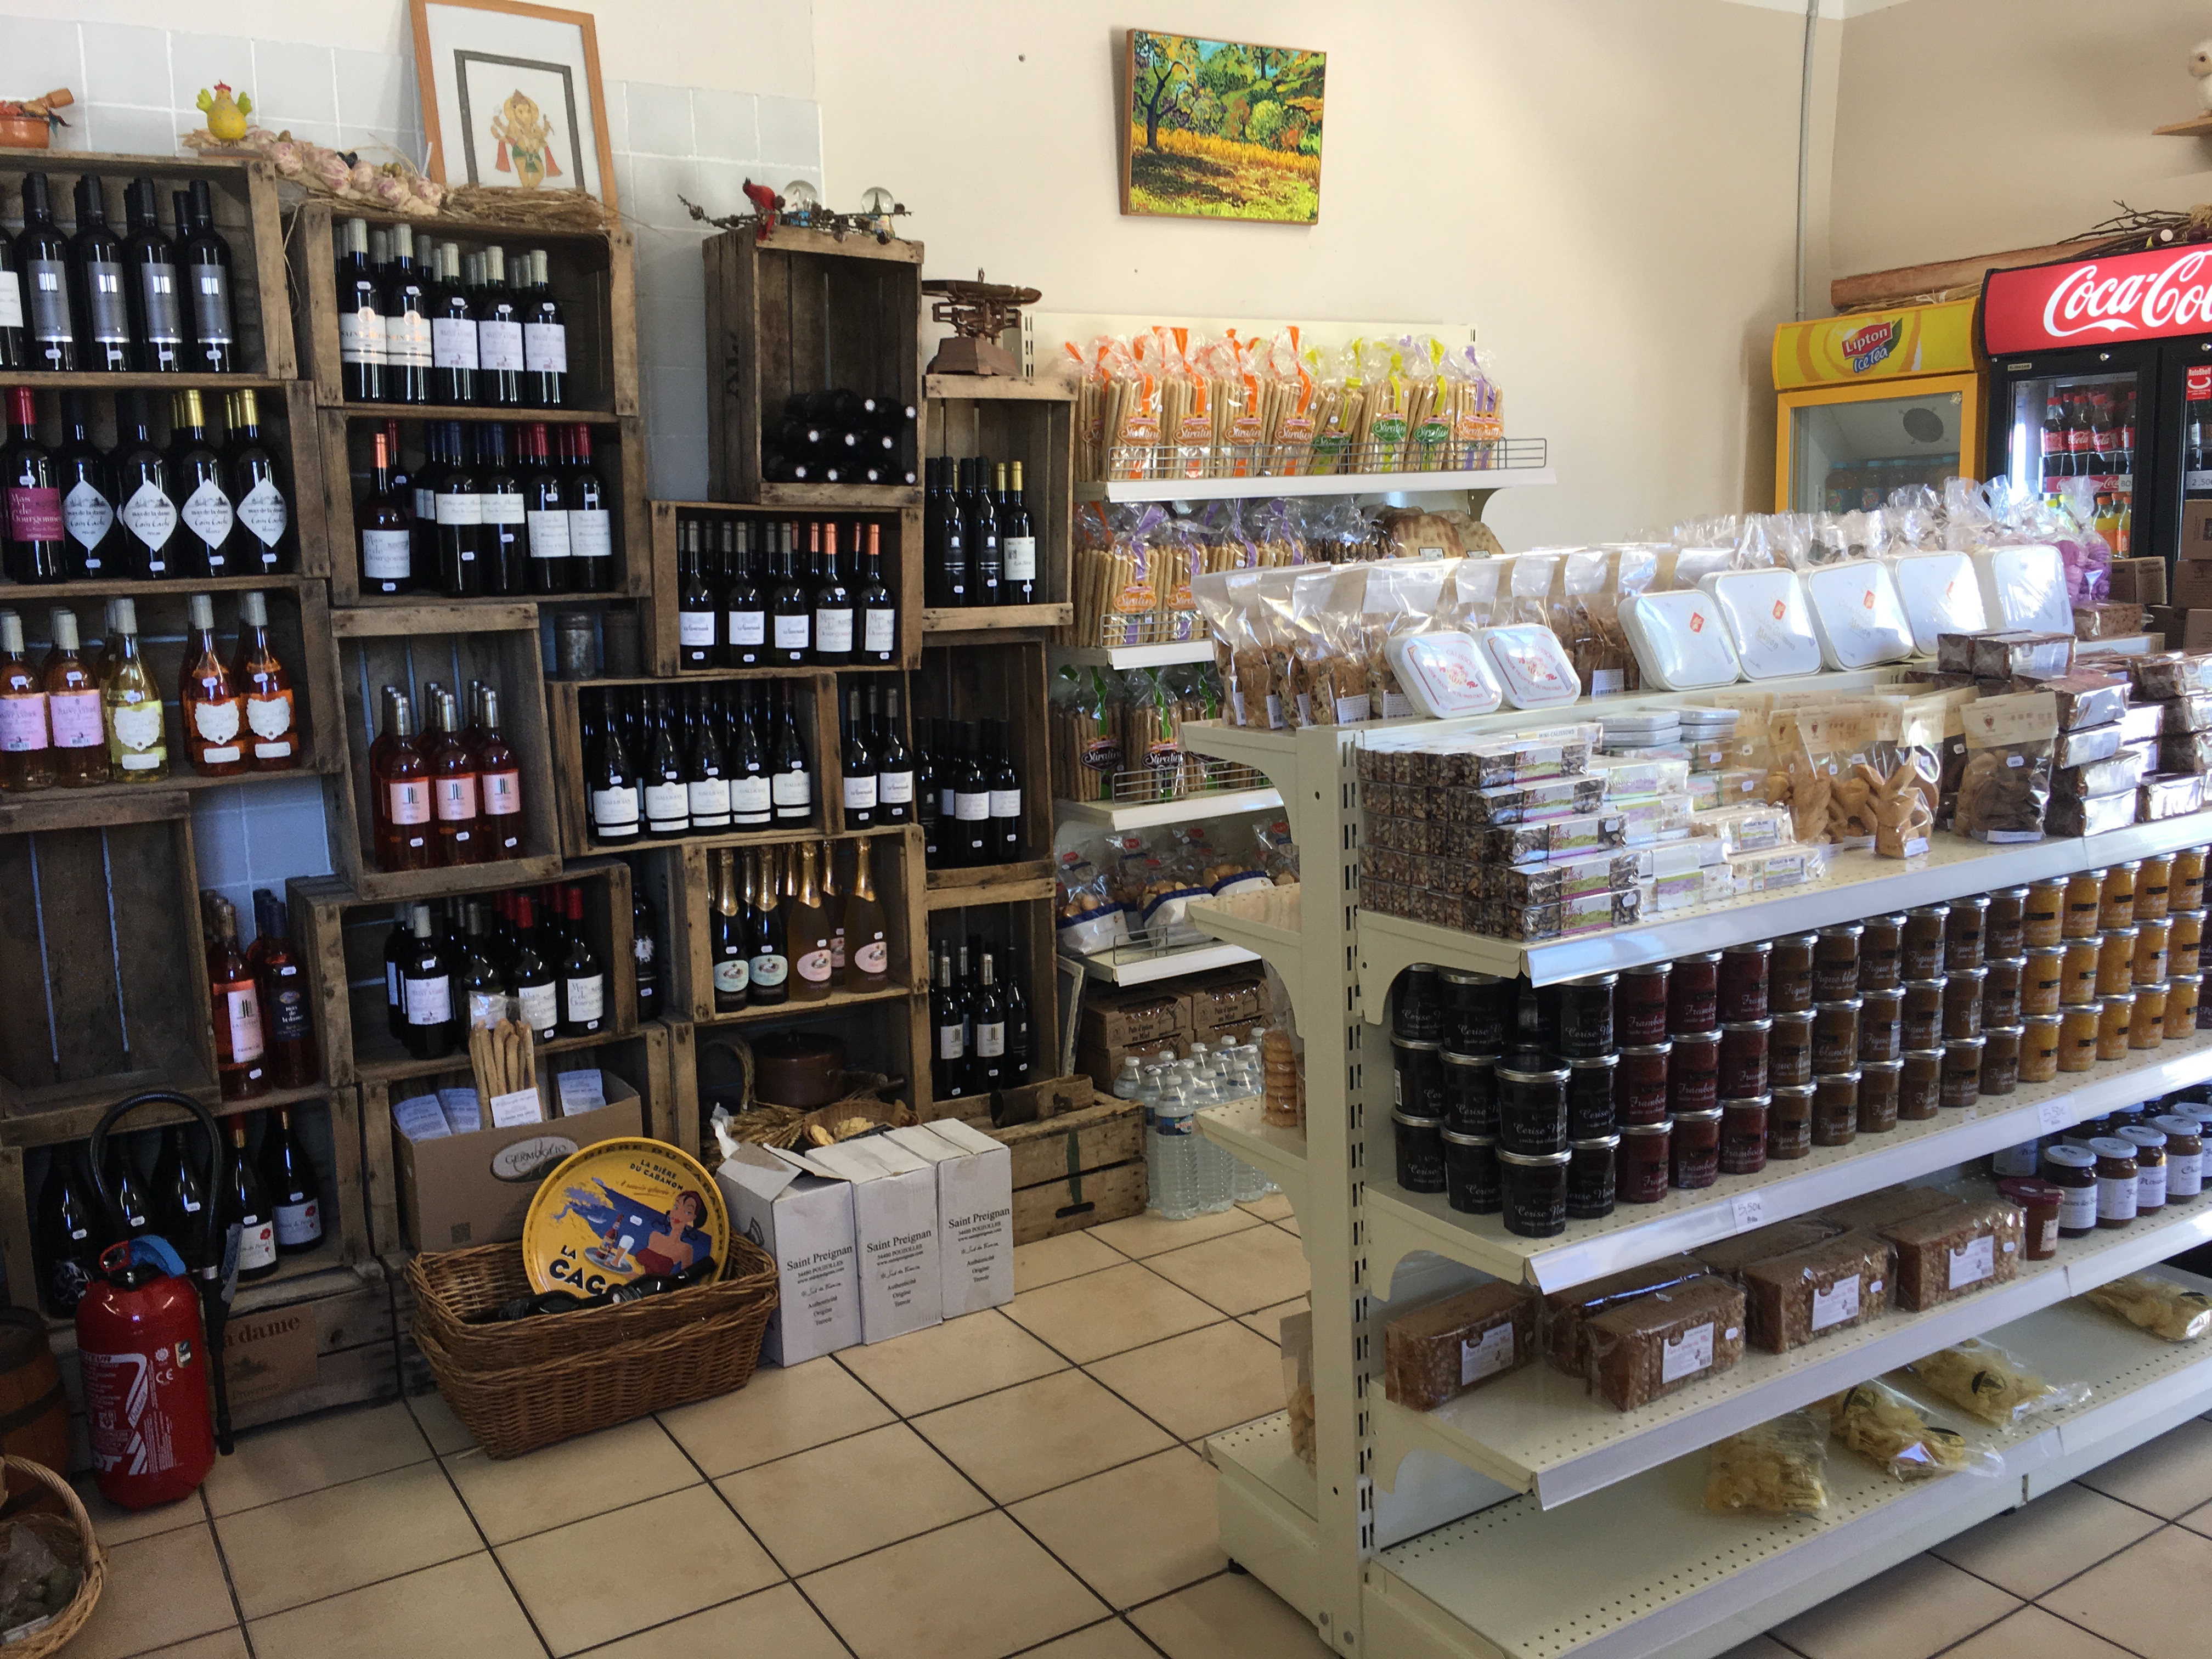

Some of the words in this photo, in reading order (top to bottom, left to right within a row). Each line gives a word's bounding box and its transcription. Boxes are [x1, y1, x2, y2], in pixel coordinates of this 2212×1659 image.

[2044, 251, 2212, 337] Coca-Co
[1846, 328, 1887, 353] Lipton
[1854, 357, 1869, 373] Ice
[1869, 347, 1888, 363] Tea
[1170, 594, 1194, 606] Stira
[1539, 729, 1575, 738] MINI-CALISSONS
[1514, 1122, 1545, 1136] Cerise
[629, 1163, 643, 1173] DU
[643, 1168, 685, 1191] CABANON
[640, 1159, 651, 1169] LA
[652, 1163, 677, 1180] BIÈRE
[949, 1215, 970, 1229] Saint
[973, 1208, 1010, 1223] Preignan
[1515, 1205, 1547, 1217] Cerise
[867, 1239, 890, 1253] Saint
[893, 1229, 932, 1246] Preignan
[561, 1245, 577, 1260] LA
[787, 1257, 810, 1271] Saint
[813, 1246, 853, 1263] Preignan
[972, 1266, 990, 1274] Origine
[892, 1290, 911, 1299] Origine
[813, 1307, 832, 1317] Origine
[238, 1315, 301, 1344] dame
[156, 1368, 173, 1384] CE
